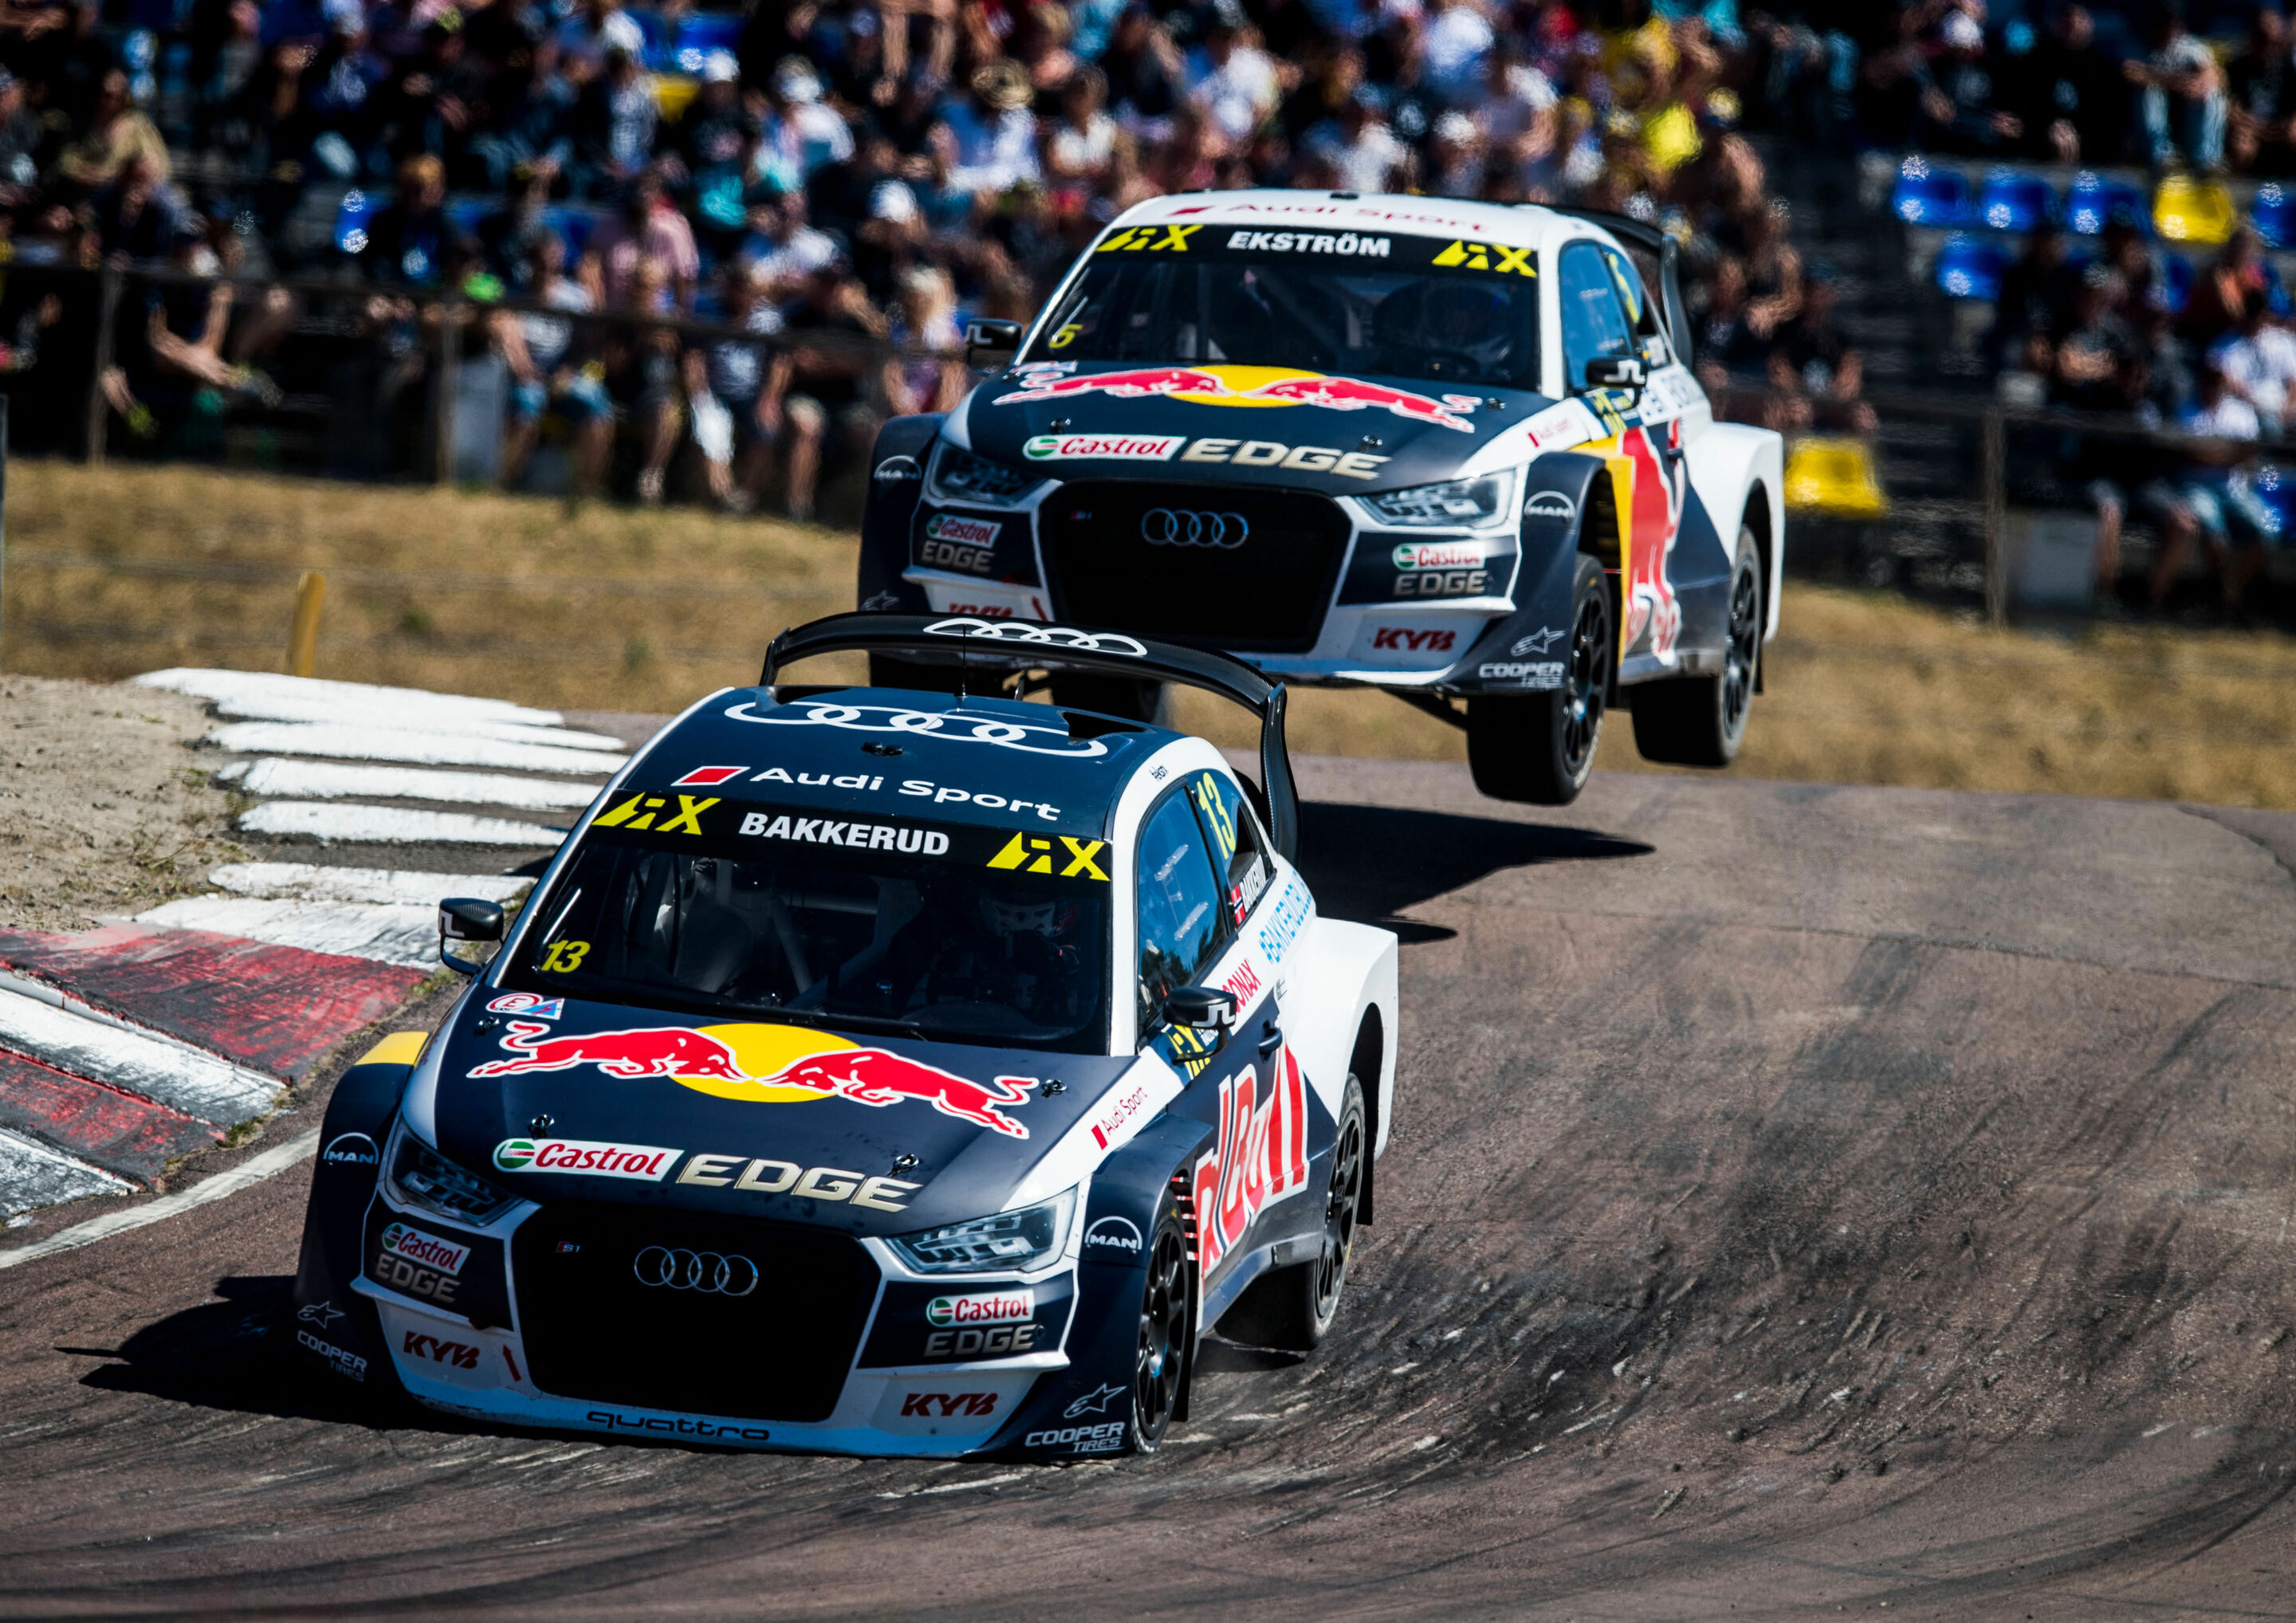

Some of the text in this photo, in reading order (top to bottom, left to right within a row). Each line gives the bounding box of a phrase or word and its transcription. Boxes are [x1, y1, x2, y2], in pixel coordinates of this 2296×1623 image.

[1226, 230, 1391, 257] EKSTRÖM
[1060, 436, 1392, 480] Castrol EDGE
[940, 518, 995, 544] Castrol
[922, 540, 995, 572] EDGE
[1418, 546, 1480, 567] Castrol
[1394, 570, 1488, 595] EDGE
[1373, 627, 1457, 651] KYB
[1480, 662, 1565, 678] COOPER
[749, 768, 1061, 821] Audi Sport
[1197, 772, 1236, 860] 13
[738, 812, 949, 855] BAKKERUD
[541, 939, 591, 973] 13
[1101, 1087, 1148, 1135] Audi Sport
[328, 1150, 375, 1164] MAN
[535, 1143, 924, 1213] Castrol EDGE
[398, 1231, 463, 1271] Castrol
[1090, 1234, 1138, 1249] MAN
[375, 1253, 462, 1303] EDGE
[954, 1295, 1029, 1323] Castrol
[297, 1330, 367, 1373] COOPER
[403, 1330, 480, 1370] KYB
[923, 1323, 1038, 1357] EDGE
[901, 1393, 998, 1417] KYB
[587, 1410, 770, 1441] quattro
[1025, 1421, 1126, 1447] COOPER
[1073, 1436, 1122, 1453] TIRES
